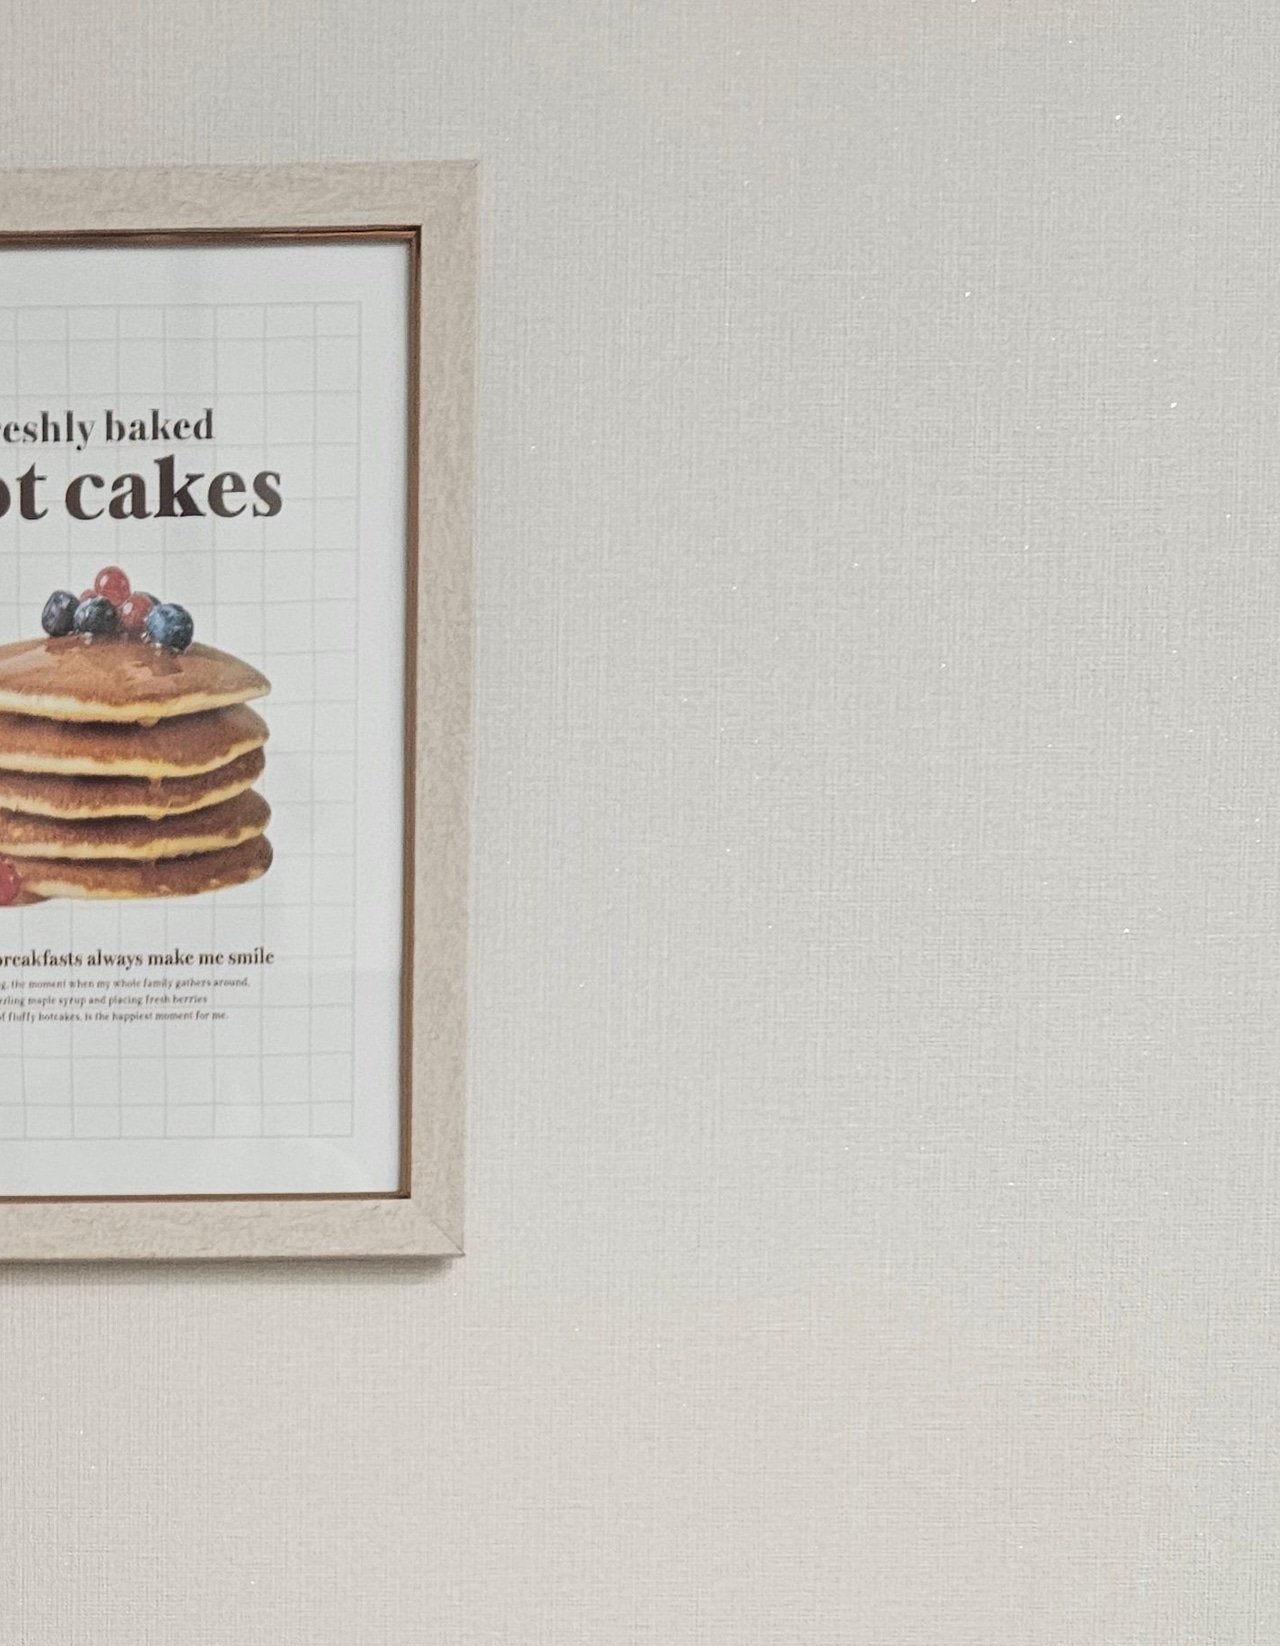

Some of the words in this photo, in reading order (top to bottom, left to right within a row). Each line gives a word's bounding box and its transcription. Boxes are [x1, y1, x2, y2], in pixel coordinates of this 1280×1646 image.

[104, 408, 214, 443] baked
[65, 454, 282, 520] cakes
[87, 949, 143, 971] always
[148, 948, 194, 966] make
[198, 953, 224, 965] me
[228, 947, 275, 965] smile
[11, 979, 26, 989] the
[28, 979, 67, 989] moment
[70, 978, 94, 988] when
[97, 980, 110, 989] my
[113, 978, 140, 988] whole
[143, 978, 173, 990] family
[175, 977, 211, 989] gathers
[28, 996, 56, 1007] maple
[58, 996, 86, 1007] syrup
[88, 995, 106, 1005] and
[108, 995, 143, 1006] placing
[145, 995, 170, 1004] fresh
[172, 994, 207, 1004] berries
[8, 1011, 35, 1023] fluffy
[95, 1012, 109, 1021] the
[112, 1011, 153, 1022] happiest
[155, 1011, 193, 1020] moment
[195, 1010, 209, 1020] for
